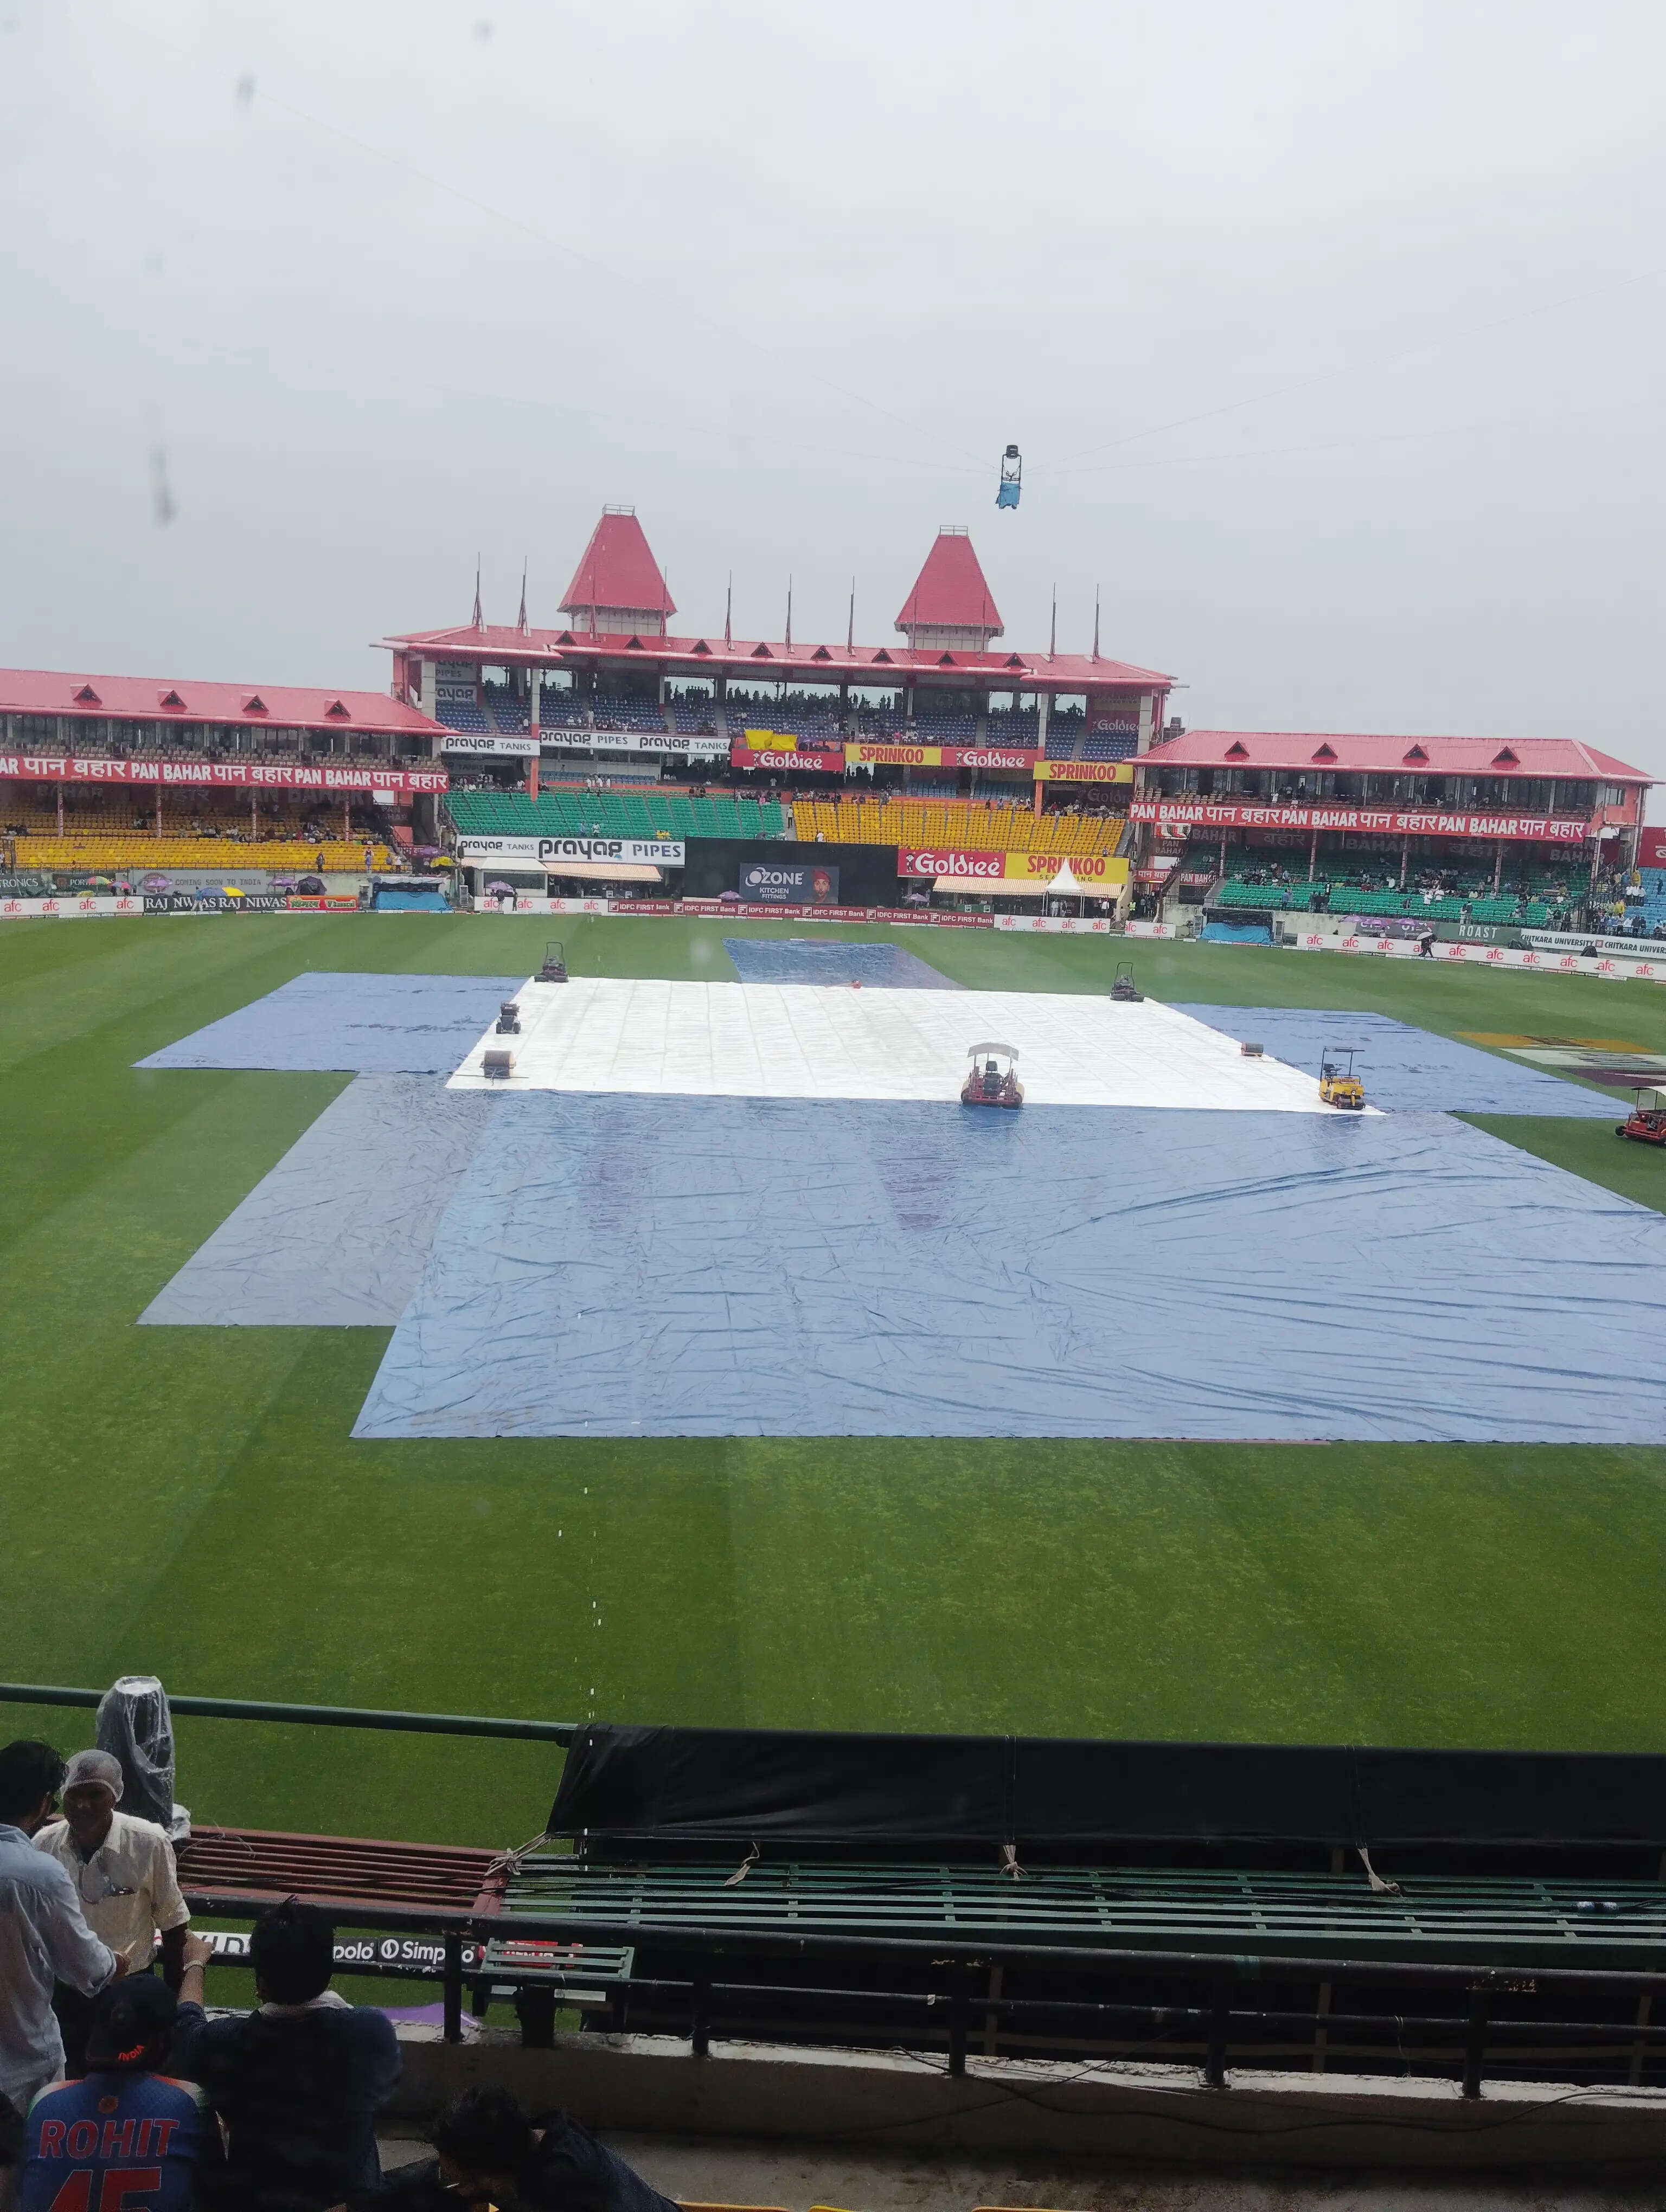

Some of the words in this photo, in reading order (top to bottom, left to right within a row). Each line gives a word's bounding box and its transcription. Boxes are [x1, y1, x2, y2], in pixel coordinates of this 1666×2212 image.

[446, 735, 495, 750] prayag
[499, 742, 531, 751] TANKS
[540, 730, 592, 745] prayag
[598, 736, 628, 745] PIPES
[639, 737, 690, 751] prayag
[695, 742, 728, 750] TANKS
[760, 751, 823, 769] Goldiee
[860, 747, 924, 764] SPRINKOO
[962, 751, 1025, 768] Goldiee
[23, 757, 67, 775] पान
[73, 759, 127, 777] बहार
[131, 763, 159, 780] PAN
[163, 764, 212, 781] BAHAR
[1049, 763, 1116, 781] SPRINKOO
[213, 765, 247, 781] पान
[251, 766, 292, 783] बहार
[294, 768, 322, 785] PAN
[325, 769, 371, 786] BAHAR
[373, 771, 405, 787] पान
[408, 773, 448, 789] बहार
[1131, 804, 1156, 819] PAN
[1159, 806, 1203, 821] BAHAR
[1206, 807, 1237, 822] पान
[1241, 808, 1280, 824] बहार
[1281, 810, 1308, 825] PAN
[1311, 811, 1357, 827] BAHAR
[1360, 813, 1393, 828] पान
[1397, 814, 1438, 831] बहार
[1438, 816, 1465, 832] PAN
[1469, 818, 1517, 834] BAHAR
[1520, 819, 1547, 835] पान
[1549, 821, 1585, 838] बहार
[460, 840, 503, 850] prayag
[539, 839, 623, 860] prayag
[632, 844, 681, 858] PIPES
[915, 851, 1001, 877] Goldiee
[745, 867, 804, 886] OZONE
[1039, 874, 1093, 882] SEAING
[1181, 873, 1193, 882] PAN
[4, 899, 22, 912] afc
[42, 898, 60, 911] afc
[79, 897, 97, 910] afc
[117, 897, 134, 909] afc
[146, 897, 168, 909] RAJ
[219, 897, 241, 909] RAJ
[246, 897, 287, 908] NIWAS
[517, 898, 533, 909] afc
[550, 898, 566, 910] afc
[584, 898, 599, 911] afc
[1002, 915, 1016, 927] afc
[1033, 917, 1047, 928] afc
[1062, 918, 1077, 929] afc
[1092, 919, 1107, 931] afc
[1153, 923, 1168, 934] afc
[1458, 925, 1497, 940] ROAST
[1306, 934, 1323, 945] afc
[1342, 937, 1360, 948] afc
[1377, 939, 1394, 950] afc
[1521, 934, 1553, 944] CHITKARA
[1554, 937, 1594, 947] UNIVERSITY
[1604, 941, 1637, 951] CHITKARA
[1449, 945, 1466, 956] afc
[1486, 948, 1504, 960] afc
[1523, 952, 1541, 964] afc
[1560, 955, 1578, 967] afc
[1598, 959, 1616, 972] afc
[1636, 963, 1654, 976] afc
[333, 1942, 374, 1959] polo
[401, 1941, 474, 1964] Simpo
[37, 2118, 180, 2159] ROHIT
